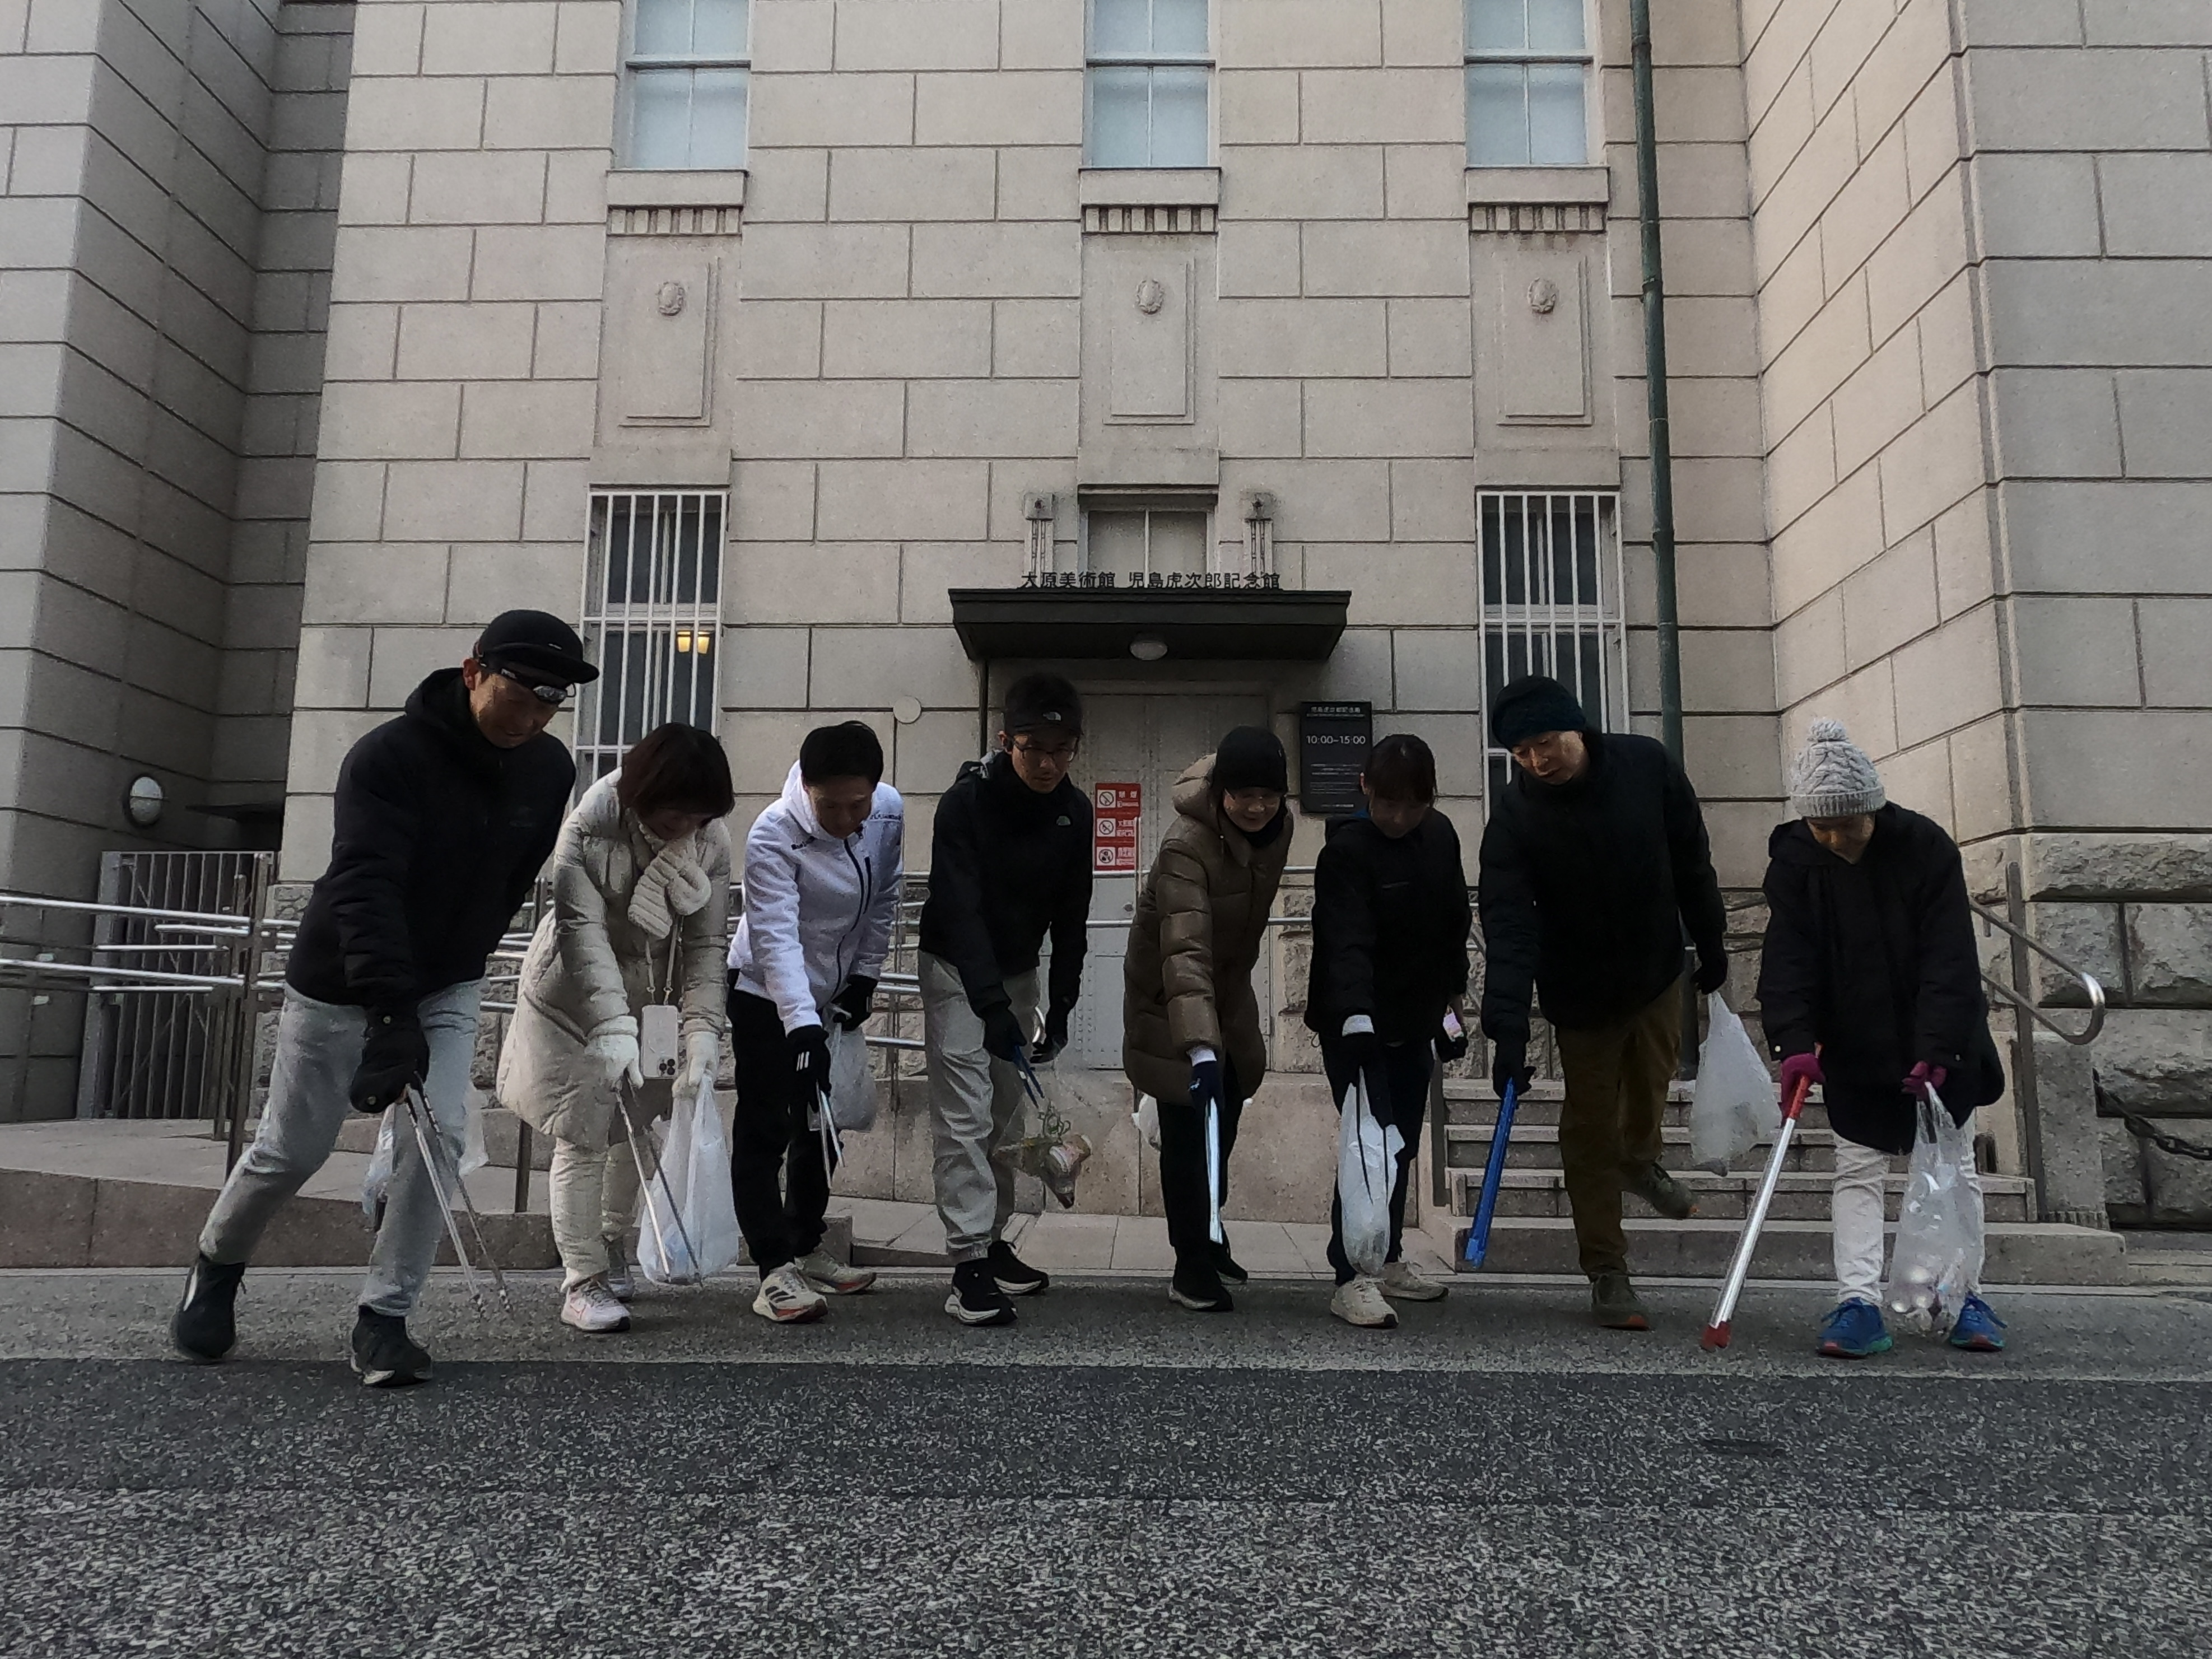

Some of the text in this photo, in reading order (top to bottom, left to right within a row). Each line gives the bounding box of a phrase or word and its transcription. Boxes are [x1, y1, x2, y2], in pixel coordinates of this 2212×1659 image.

[1021, 571, 1280, 588] 大原美術館 児島虎次郎記念館
